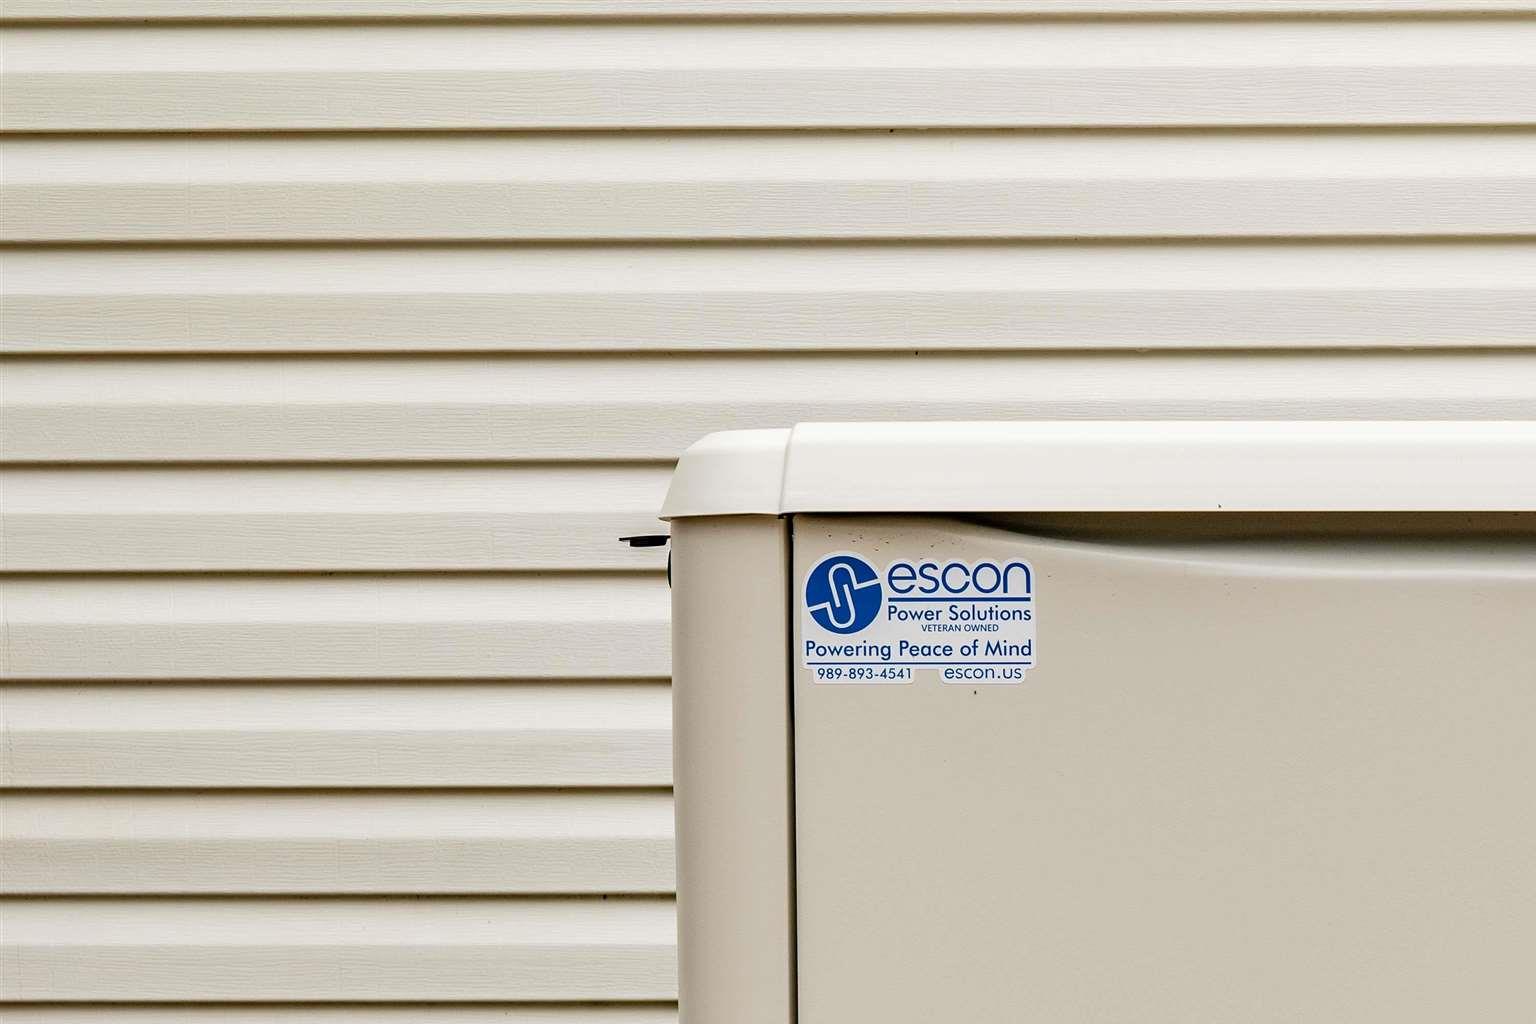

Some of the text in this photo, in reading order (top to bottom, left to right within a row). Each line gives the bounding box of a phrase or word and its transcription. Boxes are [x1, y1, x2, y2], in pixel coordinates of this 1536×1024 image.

[888, 562, 1031, 594] escon
[888, 605, 1032, 621] Power Solutions
[806, 640, 1032, 660] Powering Peace of Mind
[818, 668, 1022, 680] 989-893-4541 escon.us
